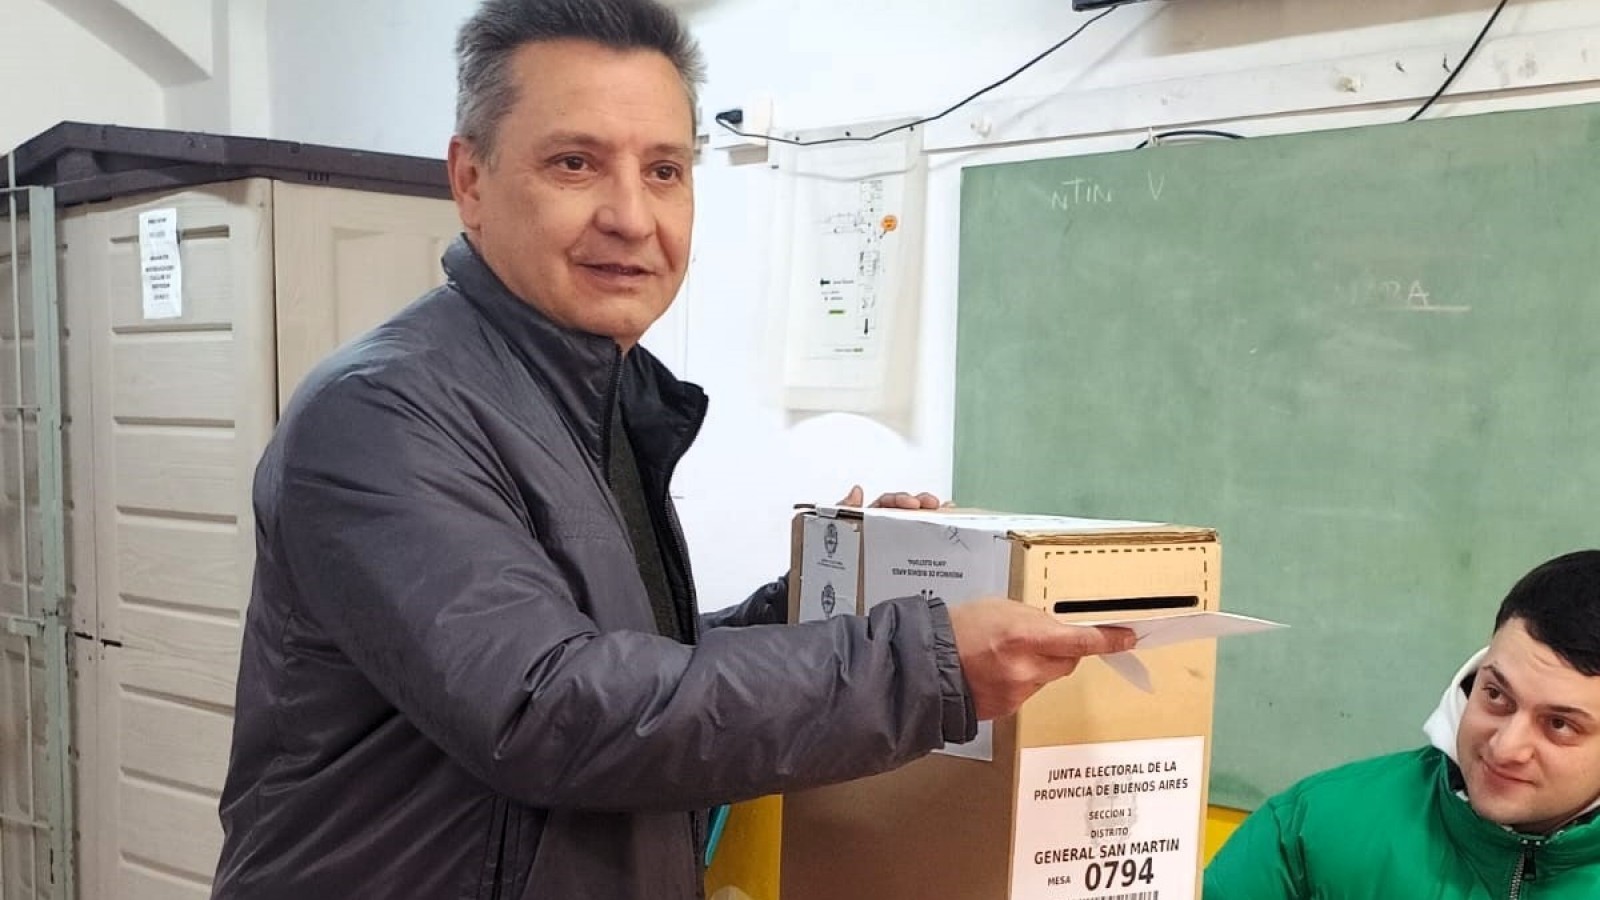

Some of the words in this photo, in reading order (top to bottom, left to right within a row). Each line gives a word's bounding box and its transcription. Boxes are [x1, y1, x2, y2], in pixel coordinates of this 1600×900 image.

[1048, 767, 1081, 783] JUNTA
[1085, 763, 1144, 778] ELECTORAL
[1148, 761, 1162, 773] DE
[1164, 760, 1177, 772] LA
[1034, 786, 1093, 801] PROVINCIA
[1096, 784, 1109, 796] DE
[1113, 781, 1155, 794] BUENOS
[1158, 778, 1189, 790] AIRES
[1088, 808, 1124, 820] SECCION
[1127, 808, 1132, 817] 1
[1090, 827, 1129, 839] DISTRITO
[1034, 846, 1095, 865] GENERAL
[1099, 843, 1125, 859] SAN
[1130, 838, 1180, 855] MARTIN
[1047, 876, 1071, 886] MESA
[1085, 857, 1154, 891] 0794
